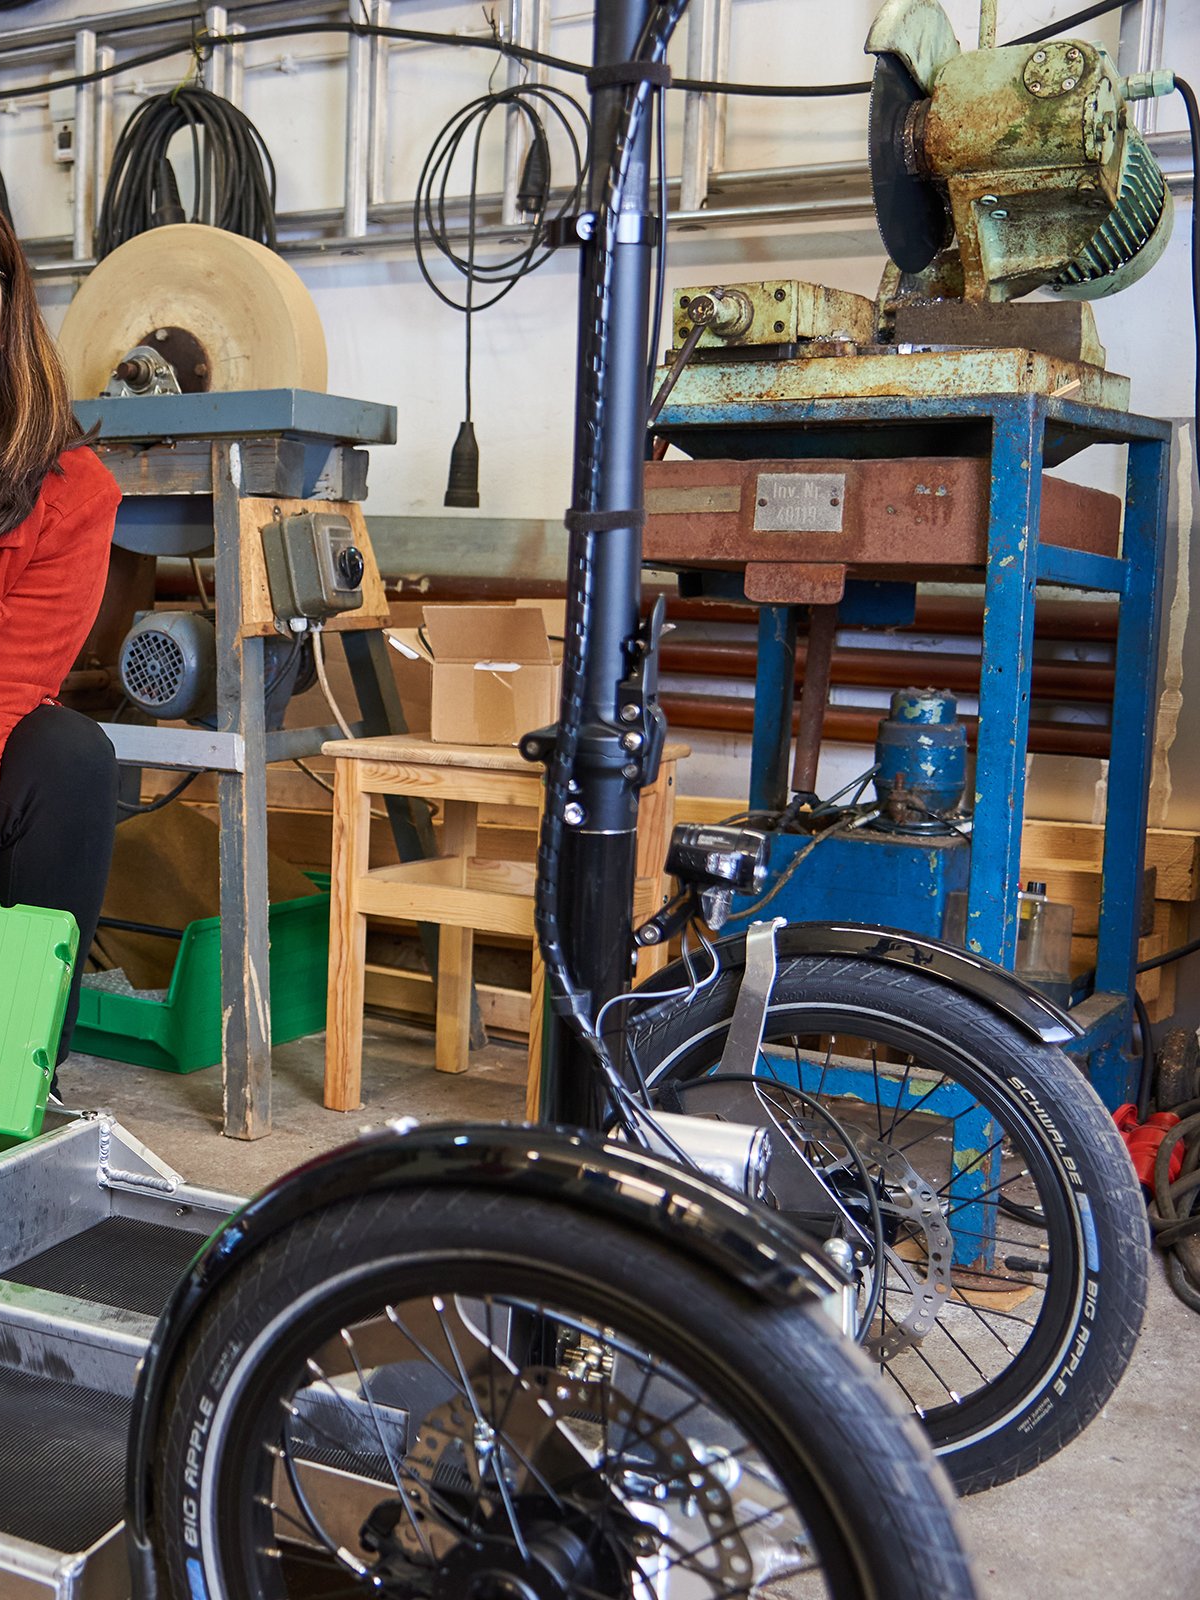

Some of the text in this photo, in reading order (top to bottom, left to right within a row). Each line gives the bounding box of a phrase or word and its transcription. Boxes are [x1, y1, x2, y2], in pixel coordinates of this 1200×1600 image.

[1007, 1076, 1083, 1186] SCHWALBE
[1054, 1279, 1098, 1396] BIG APPLE
[183, 1396, 214, 1548] BIG APPLE
